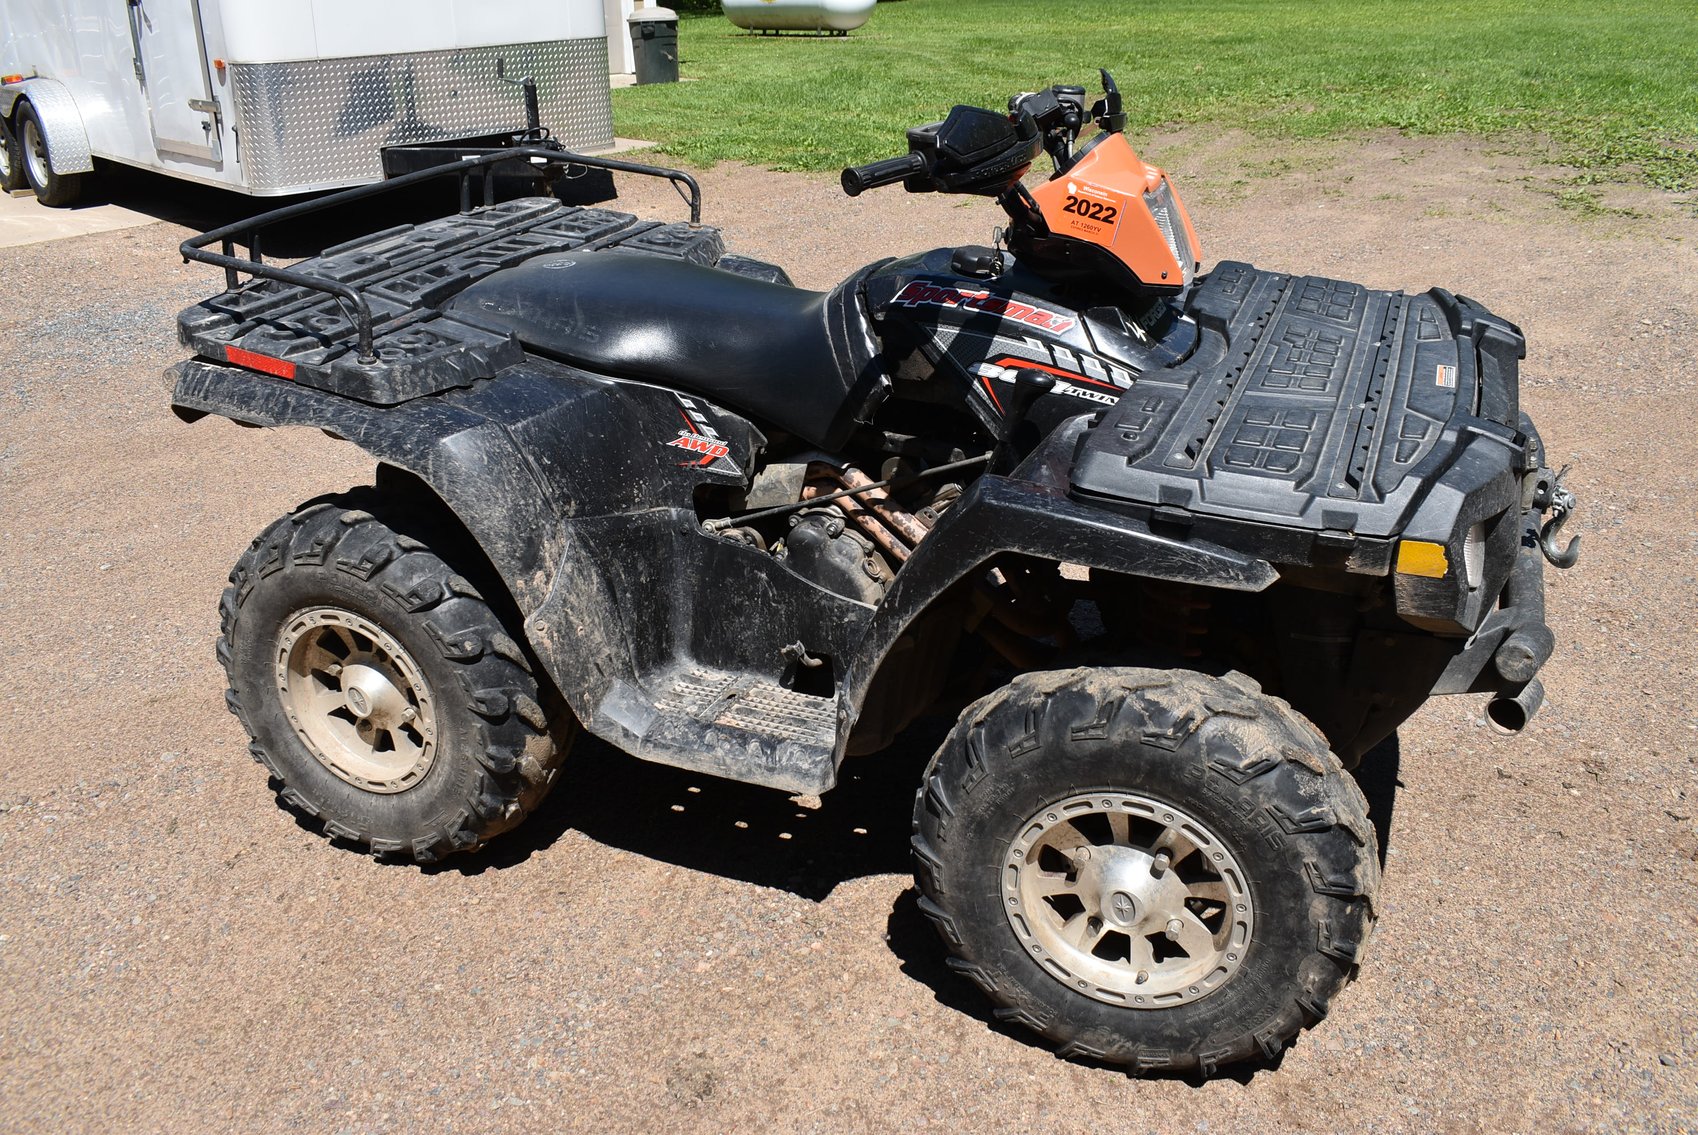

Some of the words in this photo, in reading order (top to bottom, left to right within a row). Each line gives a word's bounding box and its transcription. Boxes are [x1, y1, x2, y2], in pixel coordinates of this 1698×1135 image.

[1083, 186, 1107, 197] Wisconsin
[1062, 195, 1117, 225] 2022
[665, 437, 730, 458] AWD
[1184, 763, 1288, 850] POLARIS
